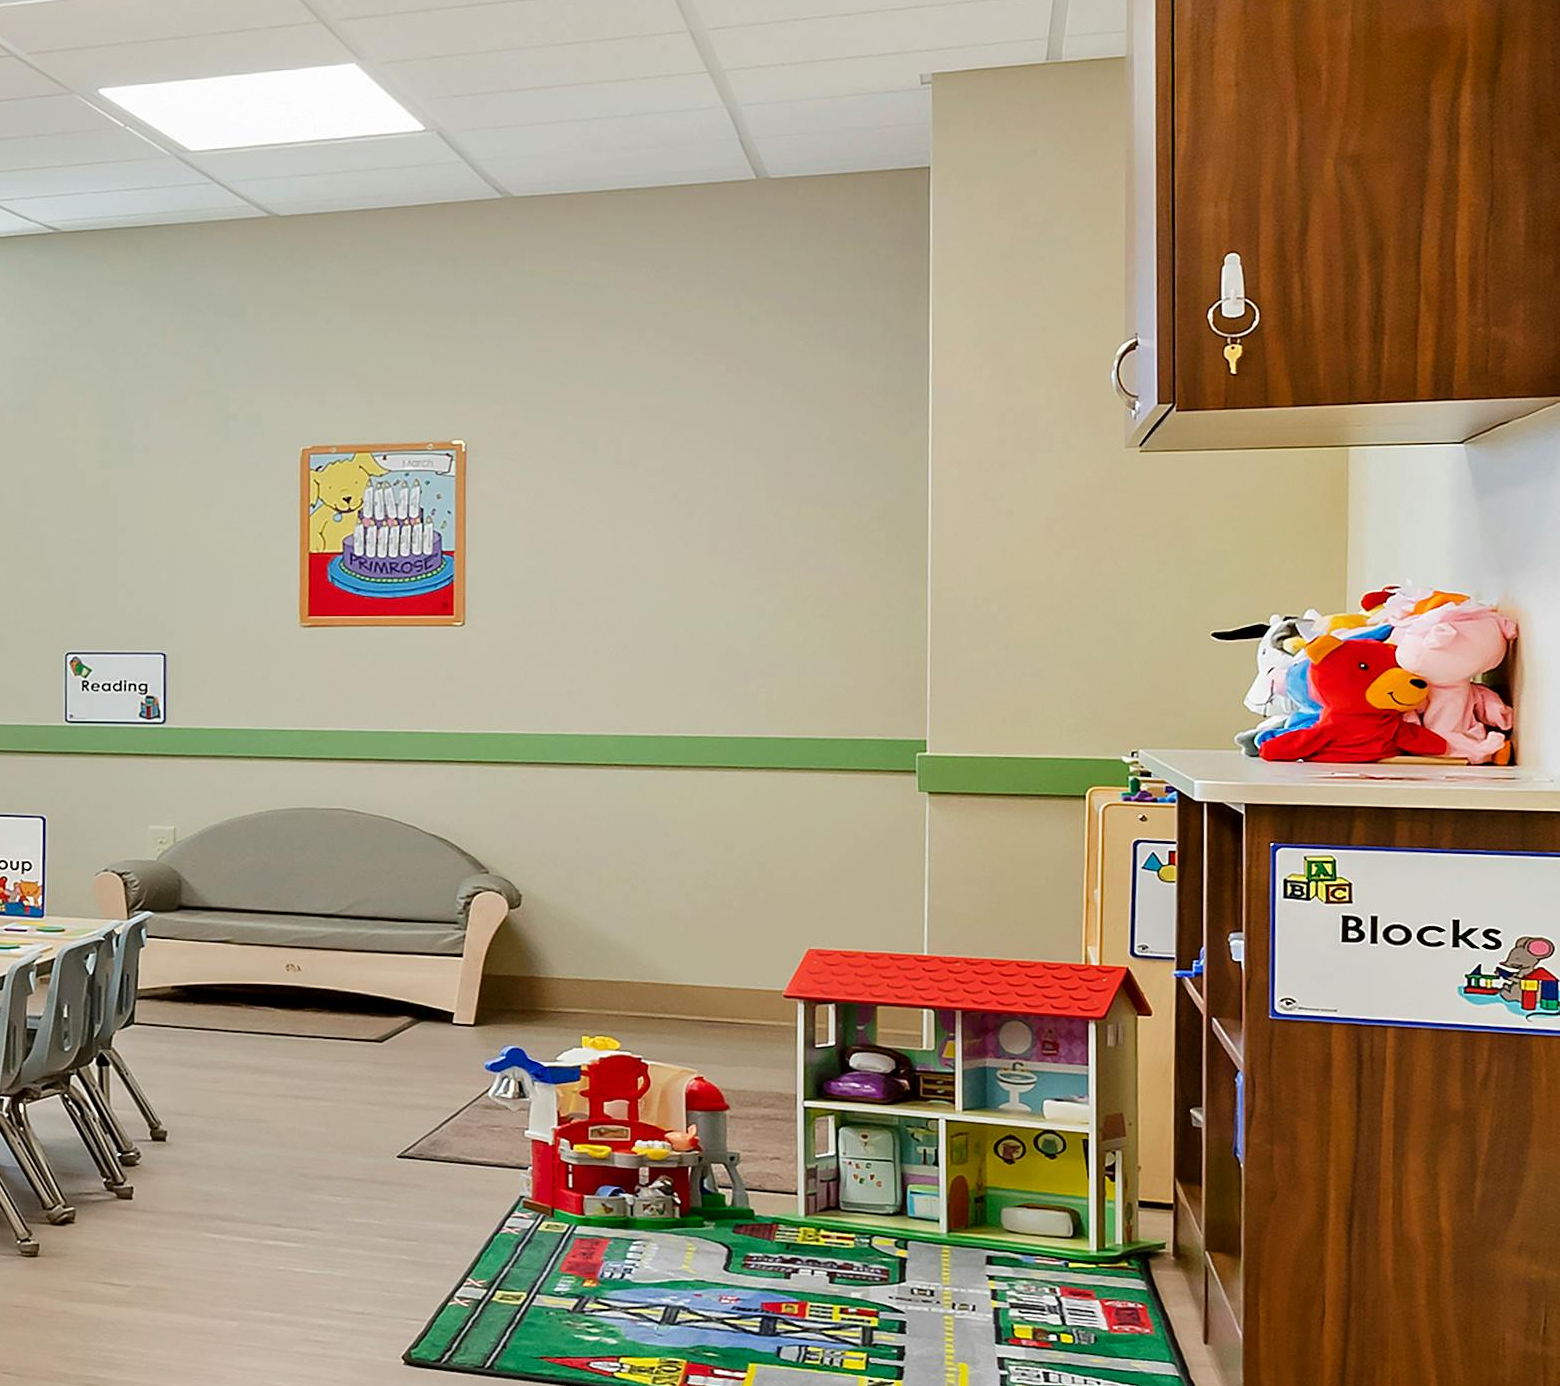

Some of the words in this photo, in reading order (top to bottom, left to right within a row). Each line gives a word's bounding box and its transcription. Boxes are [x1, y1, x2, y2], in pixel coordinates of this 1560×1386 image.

[349, 553, 438, 575] PRIMROSE
[81, 680, 149, 696] Reading
[1340, 914, 1503, 951] Blocks
